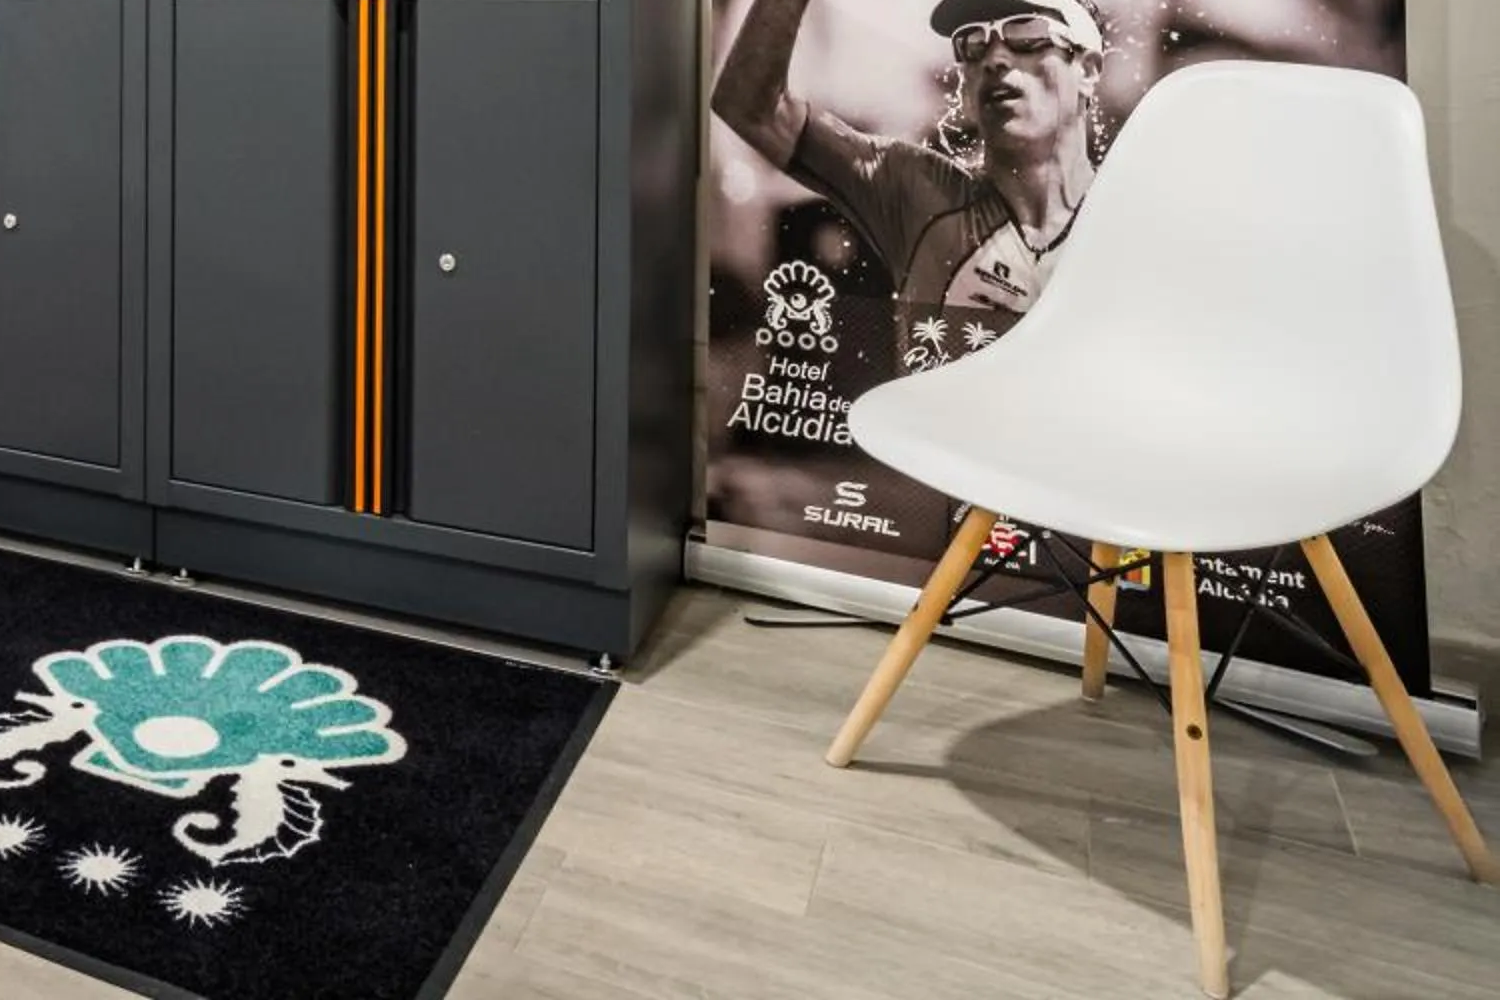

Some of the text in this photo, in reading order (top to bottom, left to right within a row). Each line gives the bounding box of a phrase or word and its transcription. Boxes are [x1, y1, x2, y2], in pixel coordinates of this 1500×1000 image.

[769, 356, 829, 382] Hotel
[741, 373, 852, 413] Bahia de
[726, 401, 853, 446] Alcúdia
[804, 505, 901, 537] SURAL
